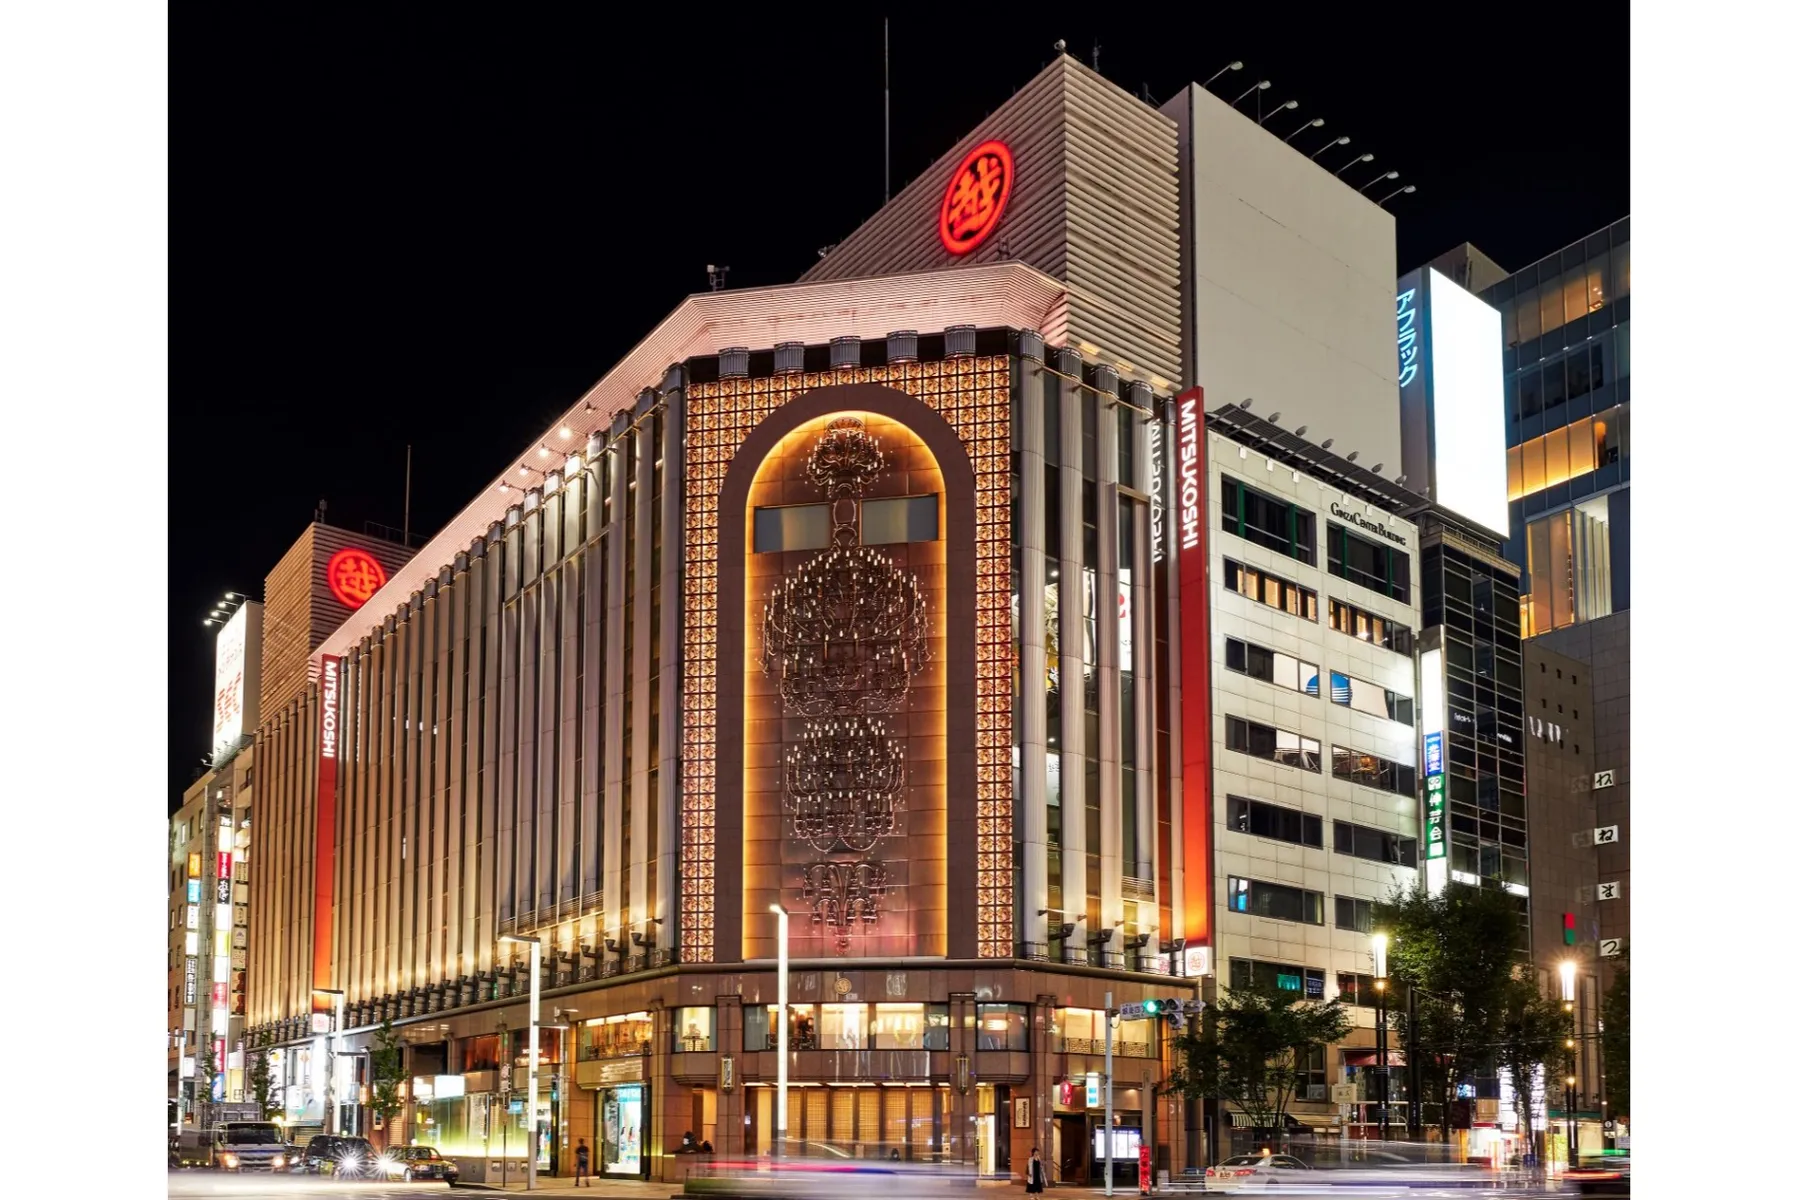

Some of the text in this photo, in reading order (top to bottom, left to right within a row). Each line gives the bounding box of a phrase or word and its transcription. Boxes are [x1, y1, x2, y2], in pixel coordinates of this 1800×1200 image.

[1396, 288, 1418, 388] アフラック
[1180, 399, 1199, 550] MITSUKOSHI
[322, 660, 338, 759] MITSUKOSHI
